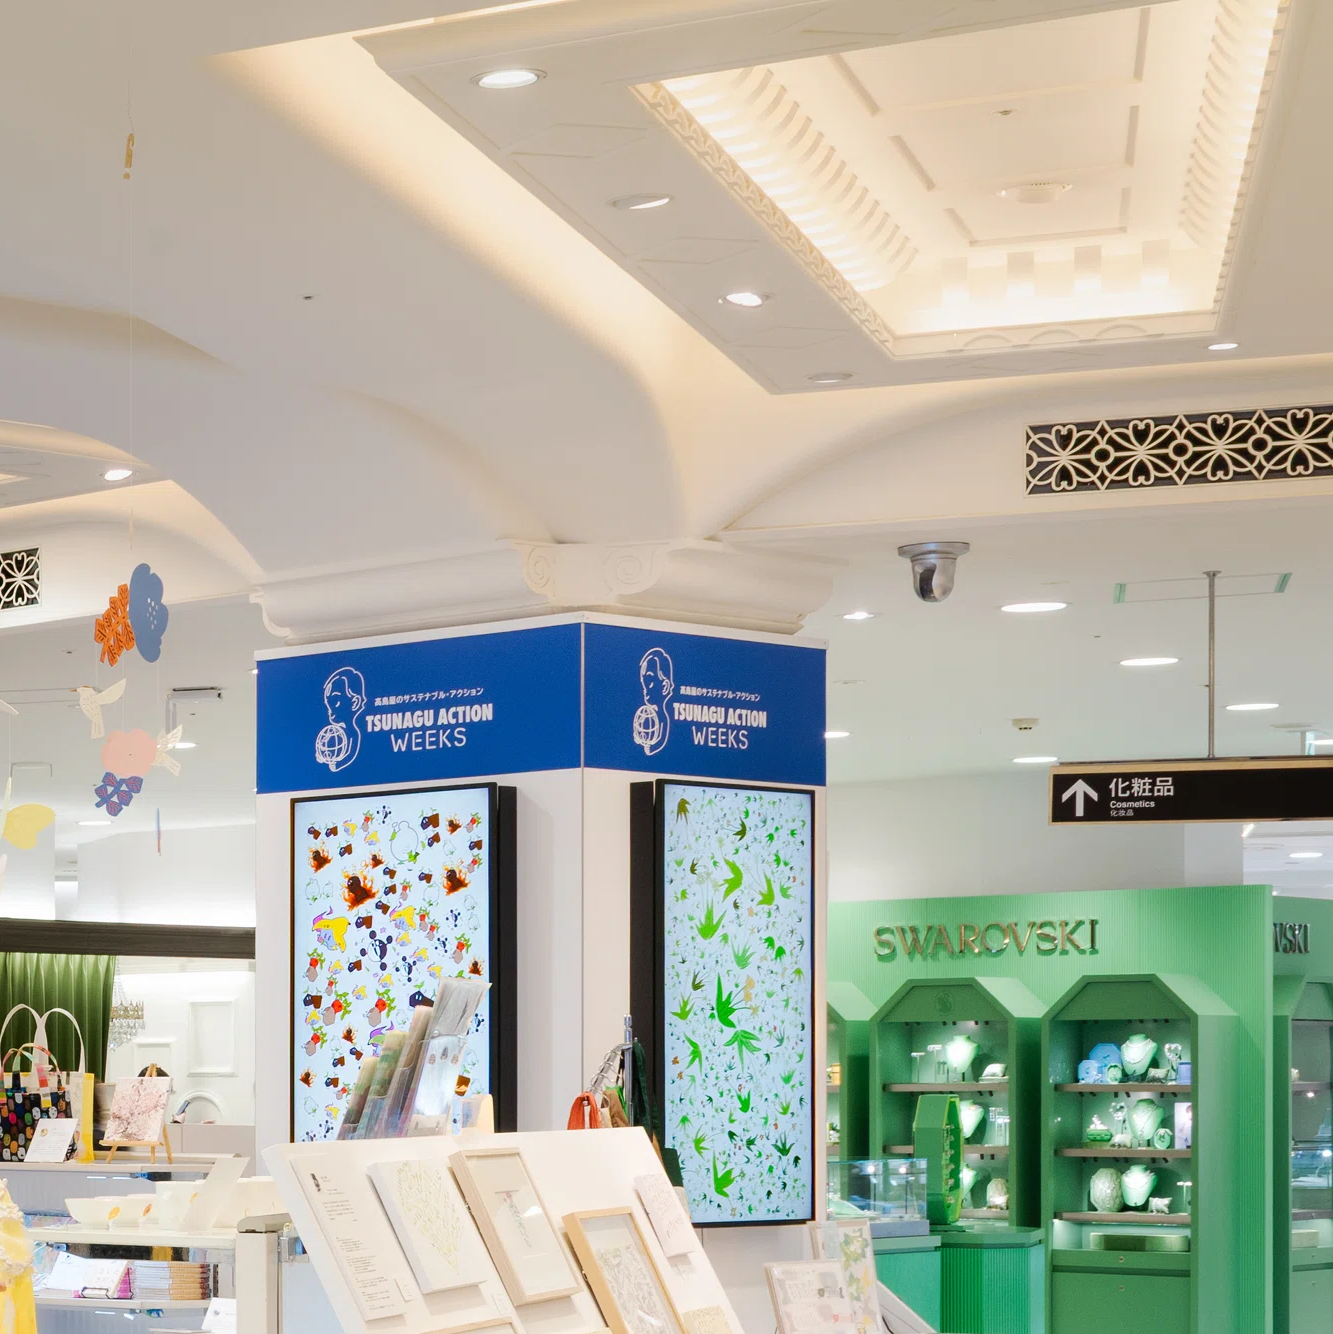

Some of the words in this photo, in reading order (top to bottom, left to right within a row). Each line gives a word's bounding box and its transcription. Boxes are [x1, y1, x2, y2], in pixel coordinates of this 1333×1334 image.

[365, 709, 435, 732] TSUNAGU
[437, 702, 494, 726] ACTION
[673, 702, 726, 725] TSUNAGU
[726, 708, 767, 728] ACTION
[390, 727, 467, 753] WEEKS
[692, 725, 749, 750] WEEKS
[1108, 777, 1175, 798] 化粧品
[1109, 800, 1156, 809] Cosmetics
[873, 918, 1099, 957] SWAROVSKI
[1272, 921, 1311, 955] VSKI
